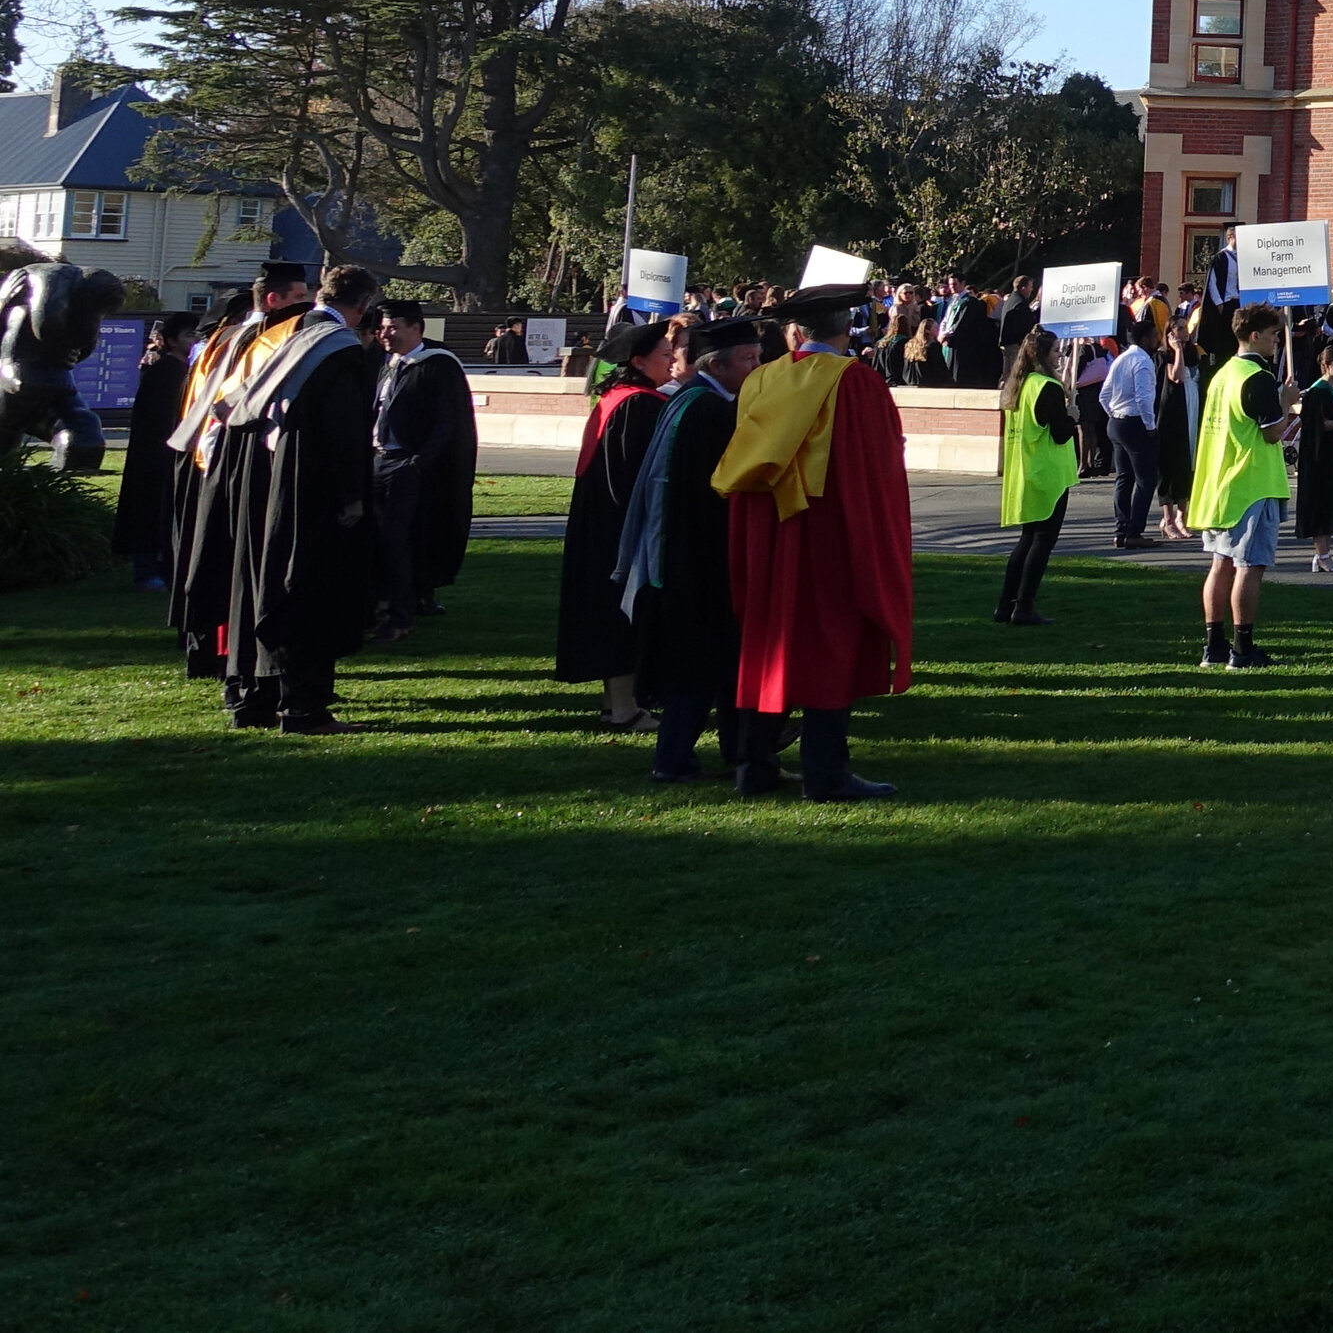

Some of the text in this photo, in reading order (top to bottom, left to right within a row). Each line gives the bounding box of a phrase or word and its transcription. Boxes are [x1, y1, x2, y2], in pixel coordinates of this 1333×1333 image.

[1257, 236, 1304, 250] Diploma in
[1271, 251, 1294, 262] Farm
[640, 269, 672, 283] Diplomas
[1253, 265, 1312, 278] Management
[1062, 283, 1096, 295] Diploma
[1050, 295, 1106, 308] in Agriculture
